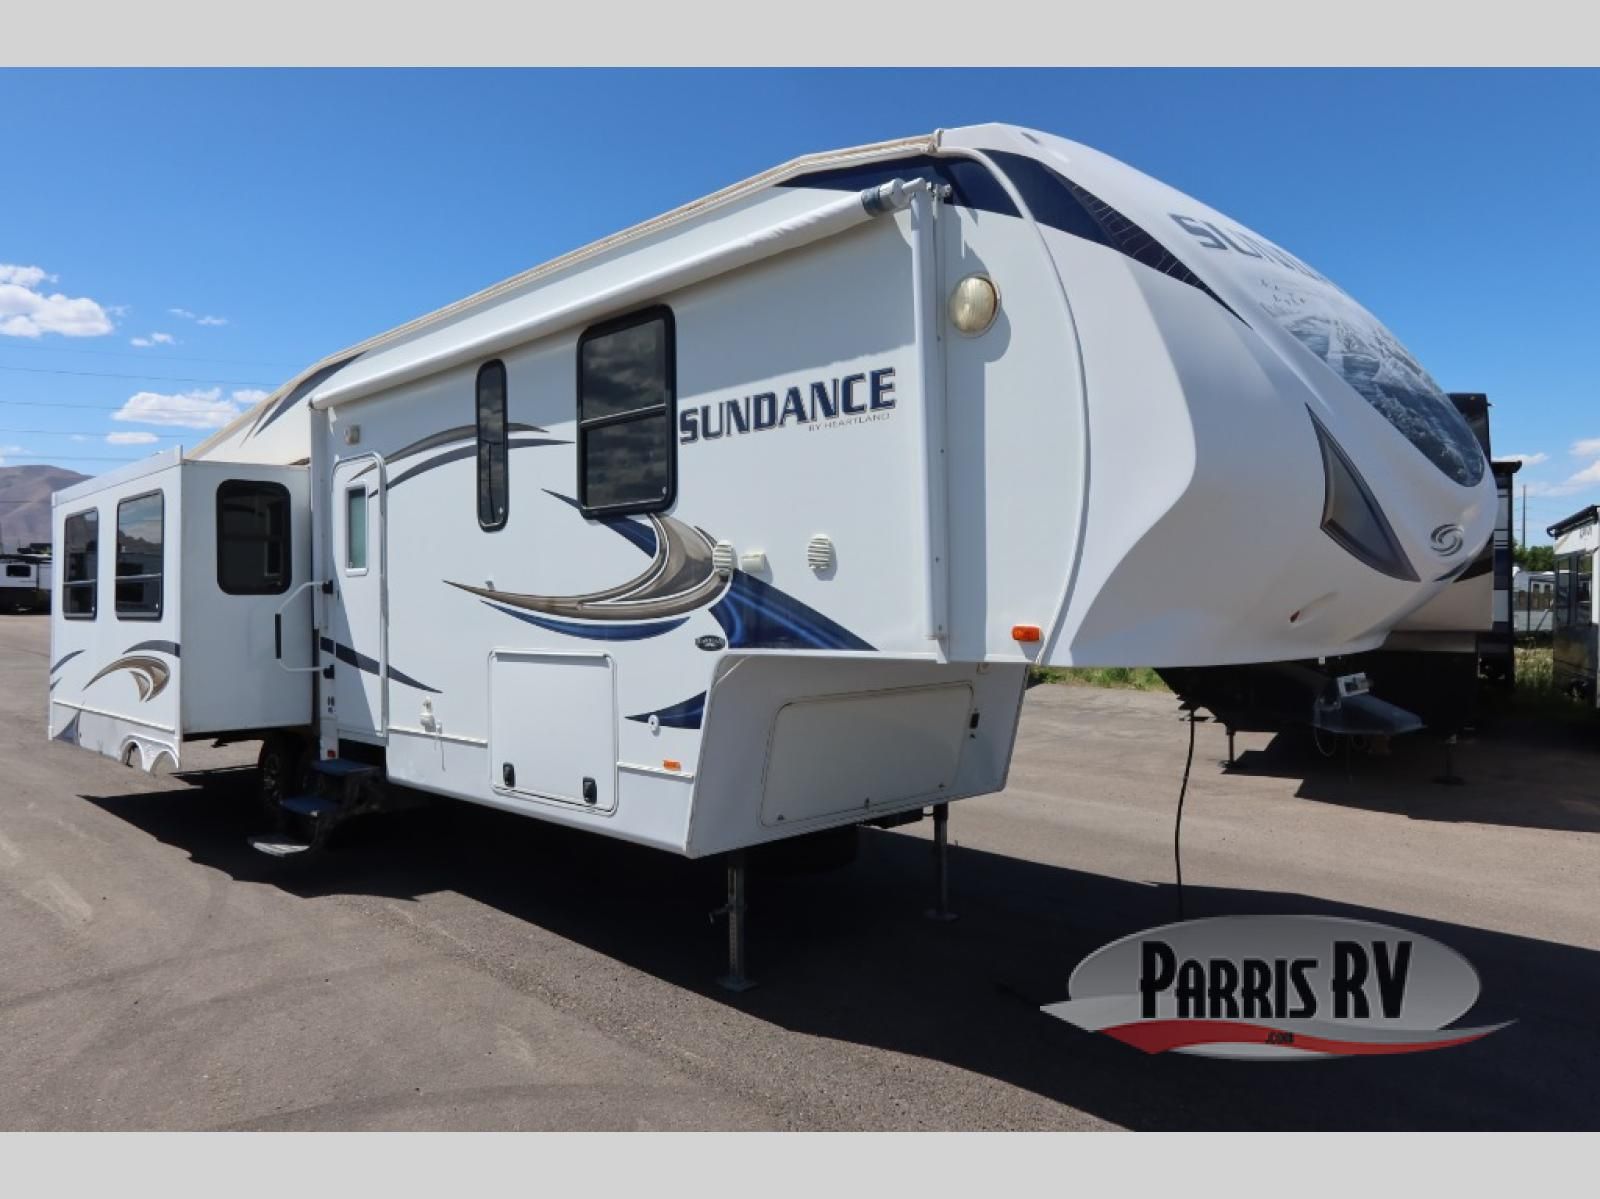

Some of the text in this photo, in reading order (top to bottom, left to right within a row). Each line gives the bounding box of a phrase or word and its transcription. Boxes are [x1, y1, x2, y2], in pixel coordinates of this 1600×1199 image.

[679, 366, 897, 445] SUNDANCE
[808, 412, 890, 432] BY HEARTLAND
